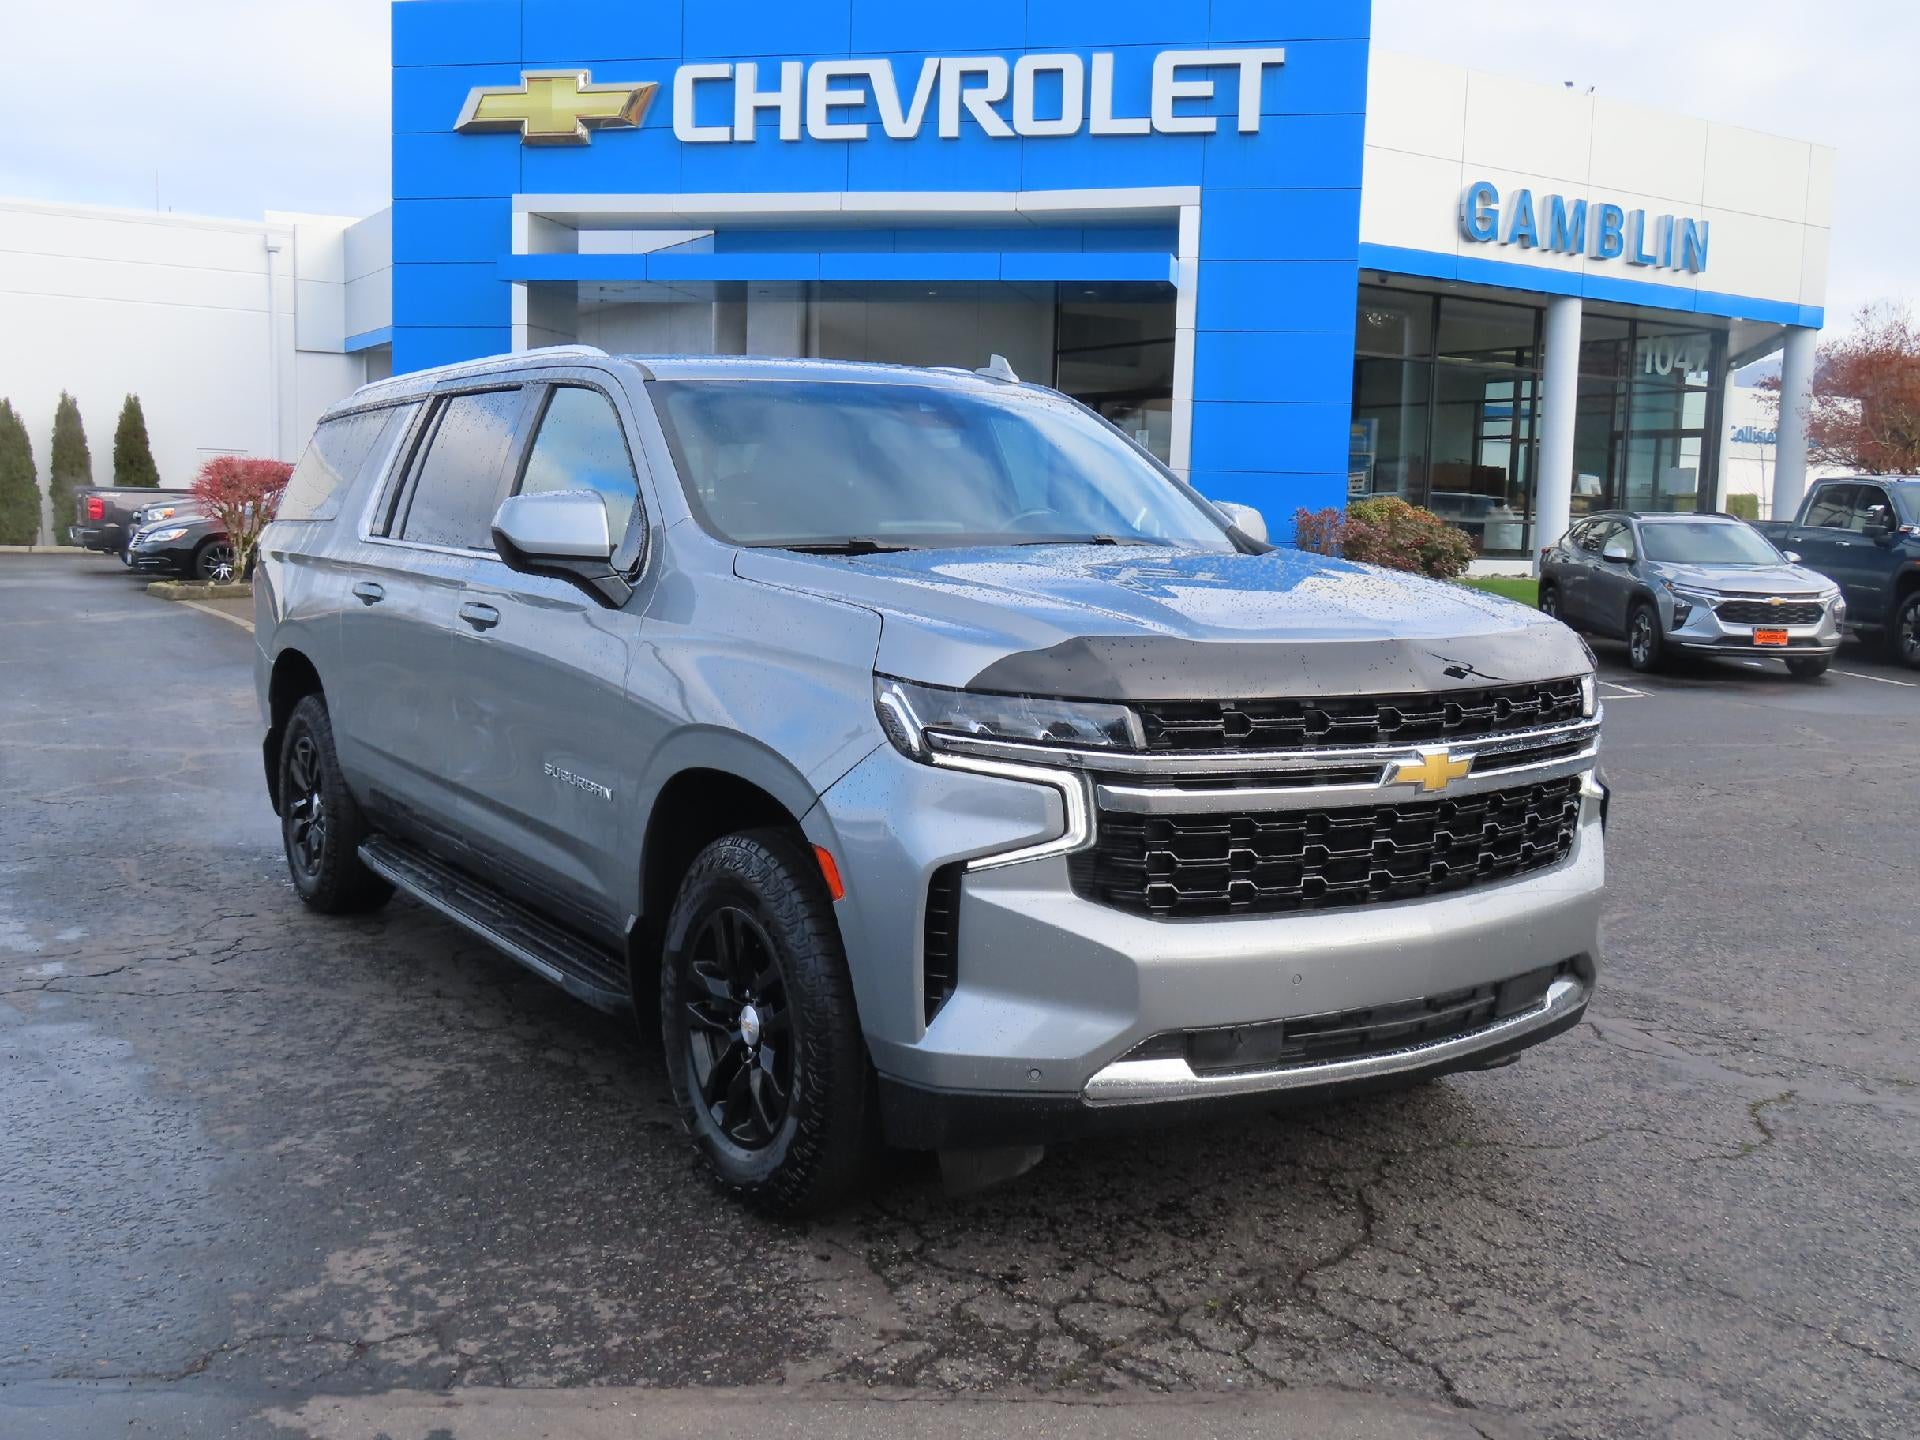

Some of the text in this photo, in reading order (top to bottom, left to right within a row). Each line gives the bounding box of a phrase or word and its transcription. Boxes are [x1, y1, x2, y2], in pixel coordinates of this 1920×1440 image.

[673, 48, 1285, 142] CHEVROLET
[1460, 181, 1709, 273] GAMBLIN
[1639, 334, 1712, 379] 1047
[1730, 425, 1777, 444] Collisio
[544, 762, 613, 801] SUBURBAN
